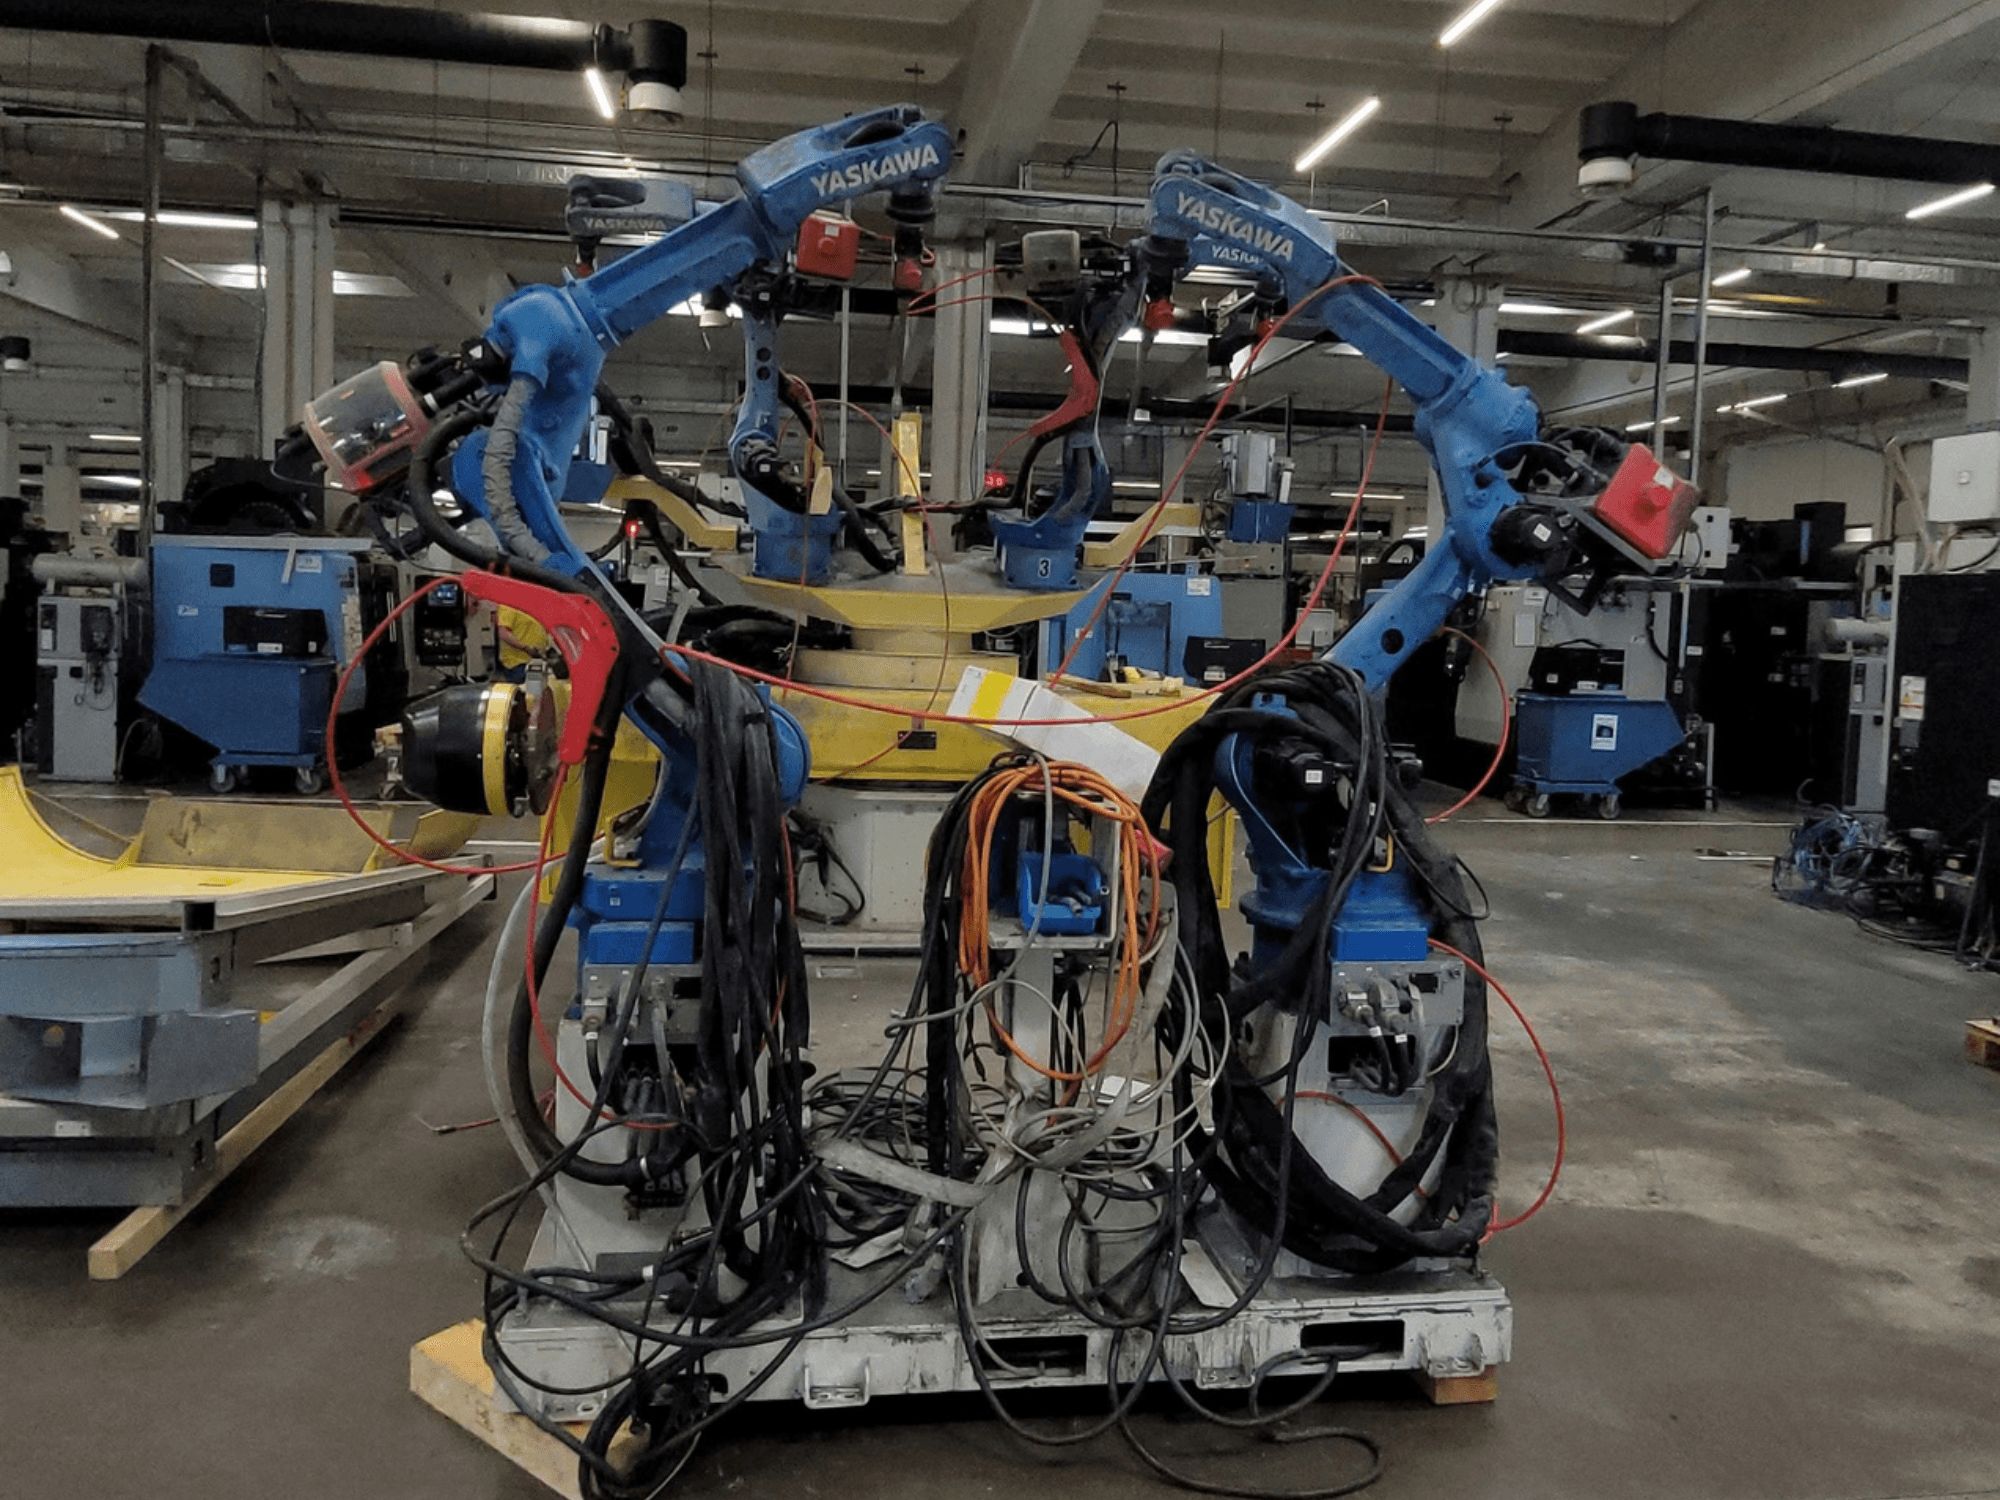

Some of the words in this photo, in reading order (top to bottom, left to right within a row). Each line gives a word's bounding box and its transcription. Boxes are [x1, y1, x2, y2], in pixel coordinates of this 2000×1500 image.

[810, 143, 940, 197] YASKAWA
[1176, 191, 1294, 262] YASKAWA
[1039, 559, 1049, 577] 3
